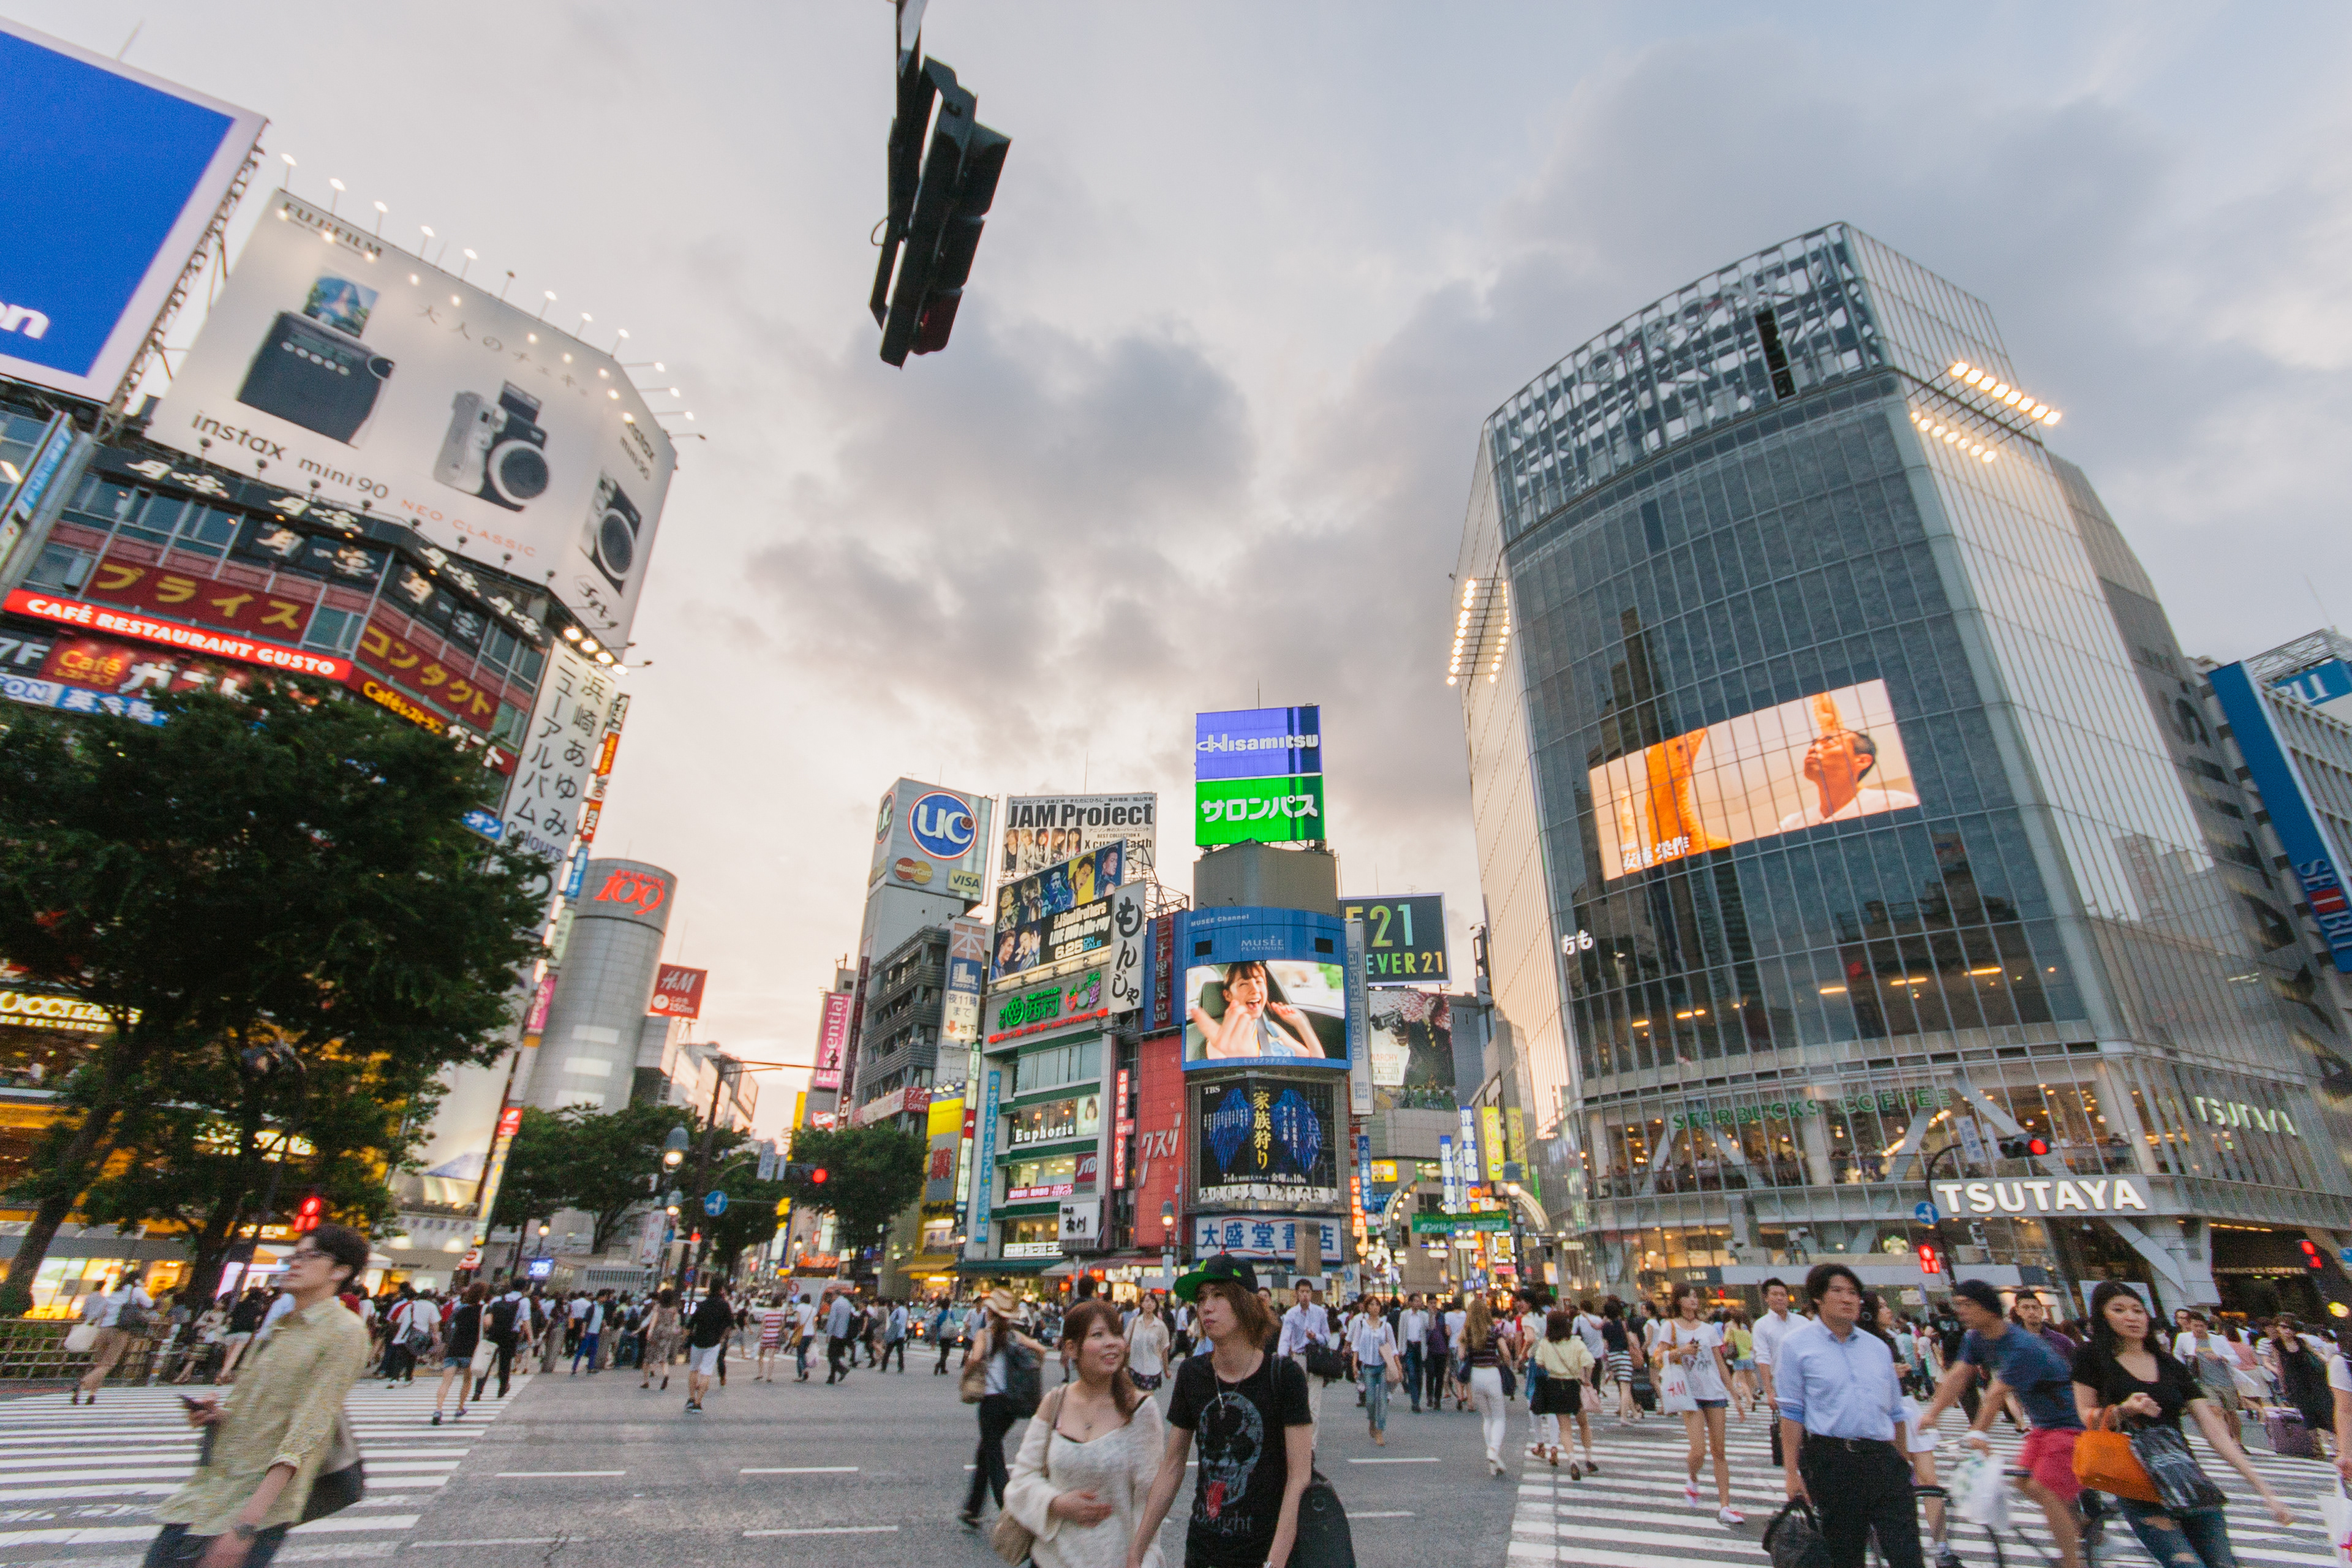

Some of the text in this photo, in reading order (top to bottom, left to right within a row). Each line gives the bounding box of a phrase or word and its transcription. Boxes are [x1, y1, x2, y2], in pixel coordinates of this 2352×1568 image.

[190, 409, 287, 461] instax
[625, 422, 655, 463] nstax
[298, 458, 389, 499] mini 90
[401, 499, 537, 557] NEO CLASSIC
[96, 564, 300, 630] プライス
[27, 599, 336, 675] CAFÉ RESTAURANT GUSTO
[59, 649, 121, 676] Café
[360, 625, 491, 715] コンタクト
[514, 654, 578, 826] ニューアルバム
[544, 669, 605, 837] 浜崎あゆみ
[1196, 734, 1319, 753] Hisamitsu
[1008, 803, 1153, 827] JAM Project
[1201, 794, 1318, 822] サロンパス
[1085, 840, 1090, 850] X
[895, 864, 933, 877] MasterCard
[953, 875, 979, 888] VISA
[594, 875, 665, 915] 109
[1191, 914, 1250, 927] MUSEE Channel
[951, 925, 985, 960] 本
[1049, 928, 1065, 946] LIVE
[1054, 936, 1095, 960] 6.25 ON
[1083, 940, 1102, 952] SALE
[1112, 896, 1143, 1006] もんじゃ
[1421, 951, 1444, 973] 21
[660, 970, 696, 993] H&M
[669, 1002, 695, 1014] 150m
[948, 993, 978, 1008] 夜11時
[952, 1005, 972, 1018] まで
[1025, 995, 1060, 1022] 西村
[1348, 941, 1363, 1060] Taisei neon
[960, 1022, 976, 1035] 地下
[1204, 1085, 1221, 1095] TBS
[1673, 1088, 1953, 1129] STARBUCKS COFFEE
[1015, 1122, 1074, 1143] Euphoria
[1253, 1091, 1272, 1170] 家族狩り
[1139, 1112, 1182, 1188] クスリ
[1077, 1156, 1097, 1177] JTB
[1936, 1179, 2147, 1213] TSUTAYA
